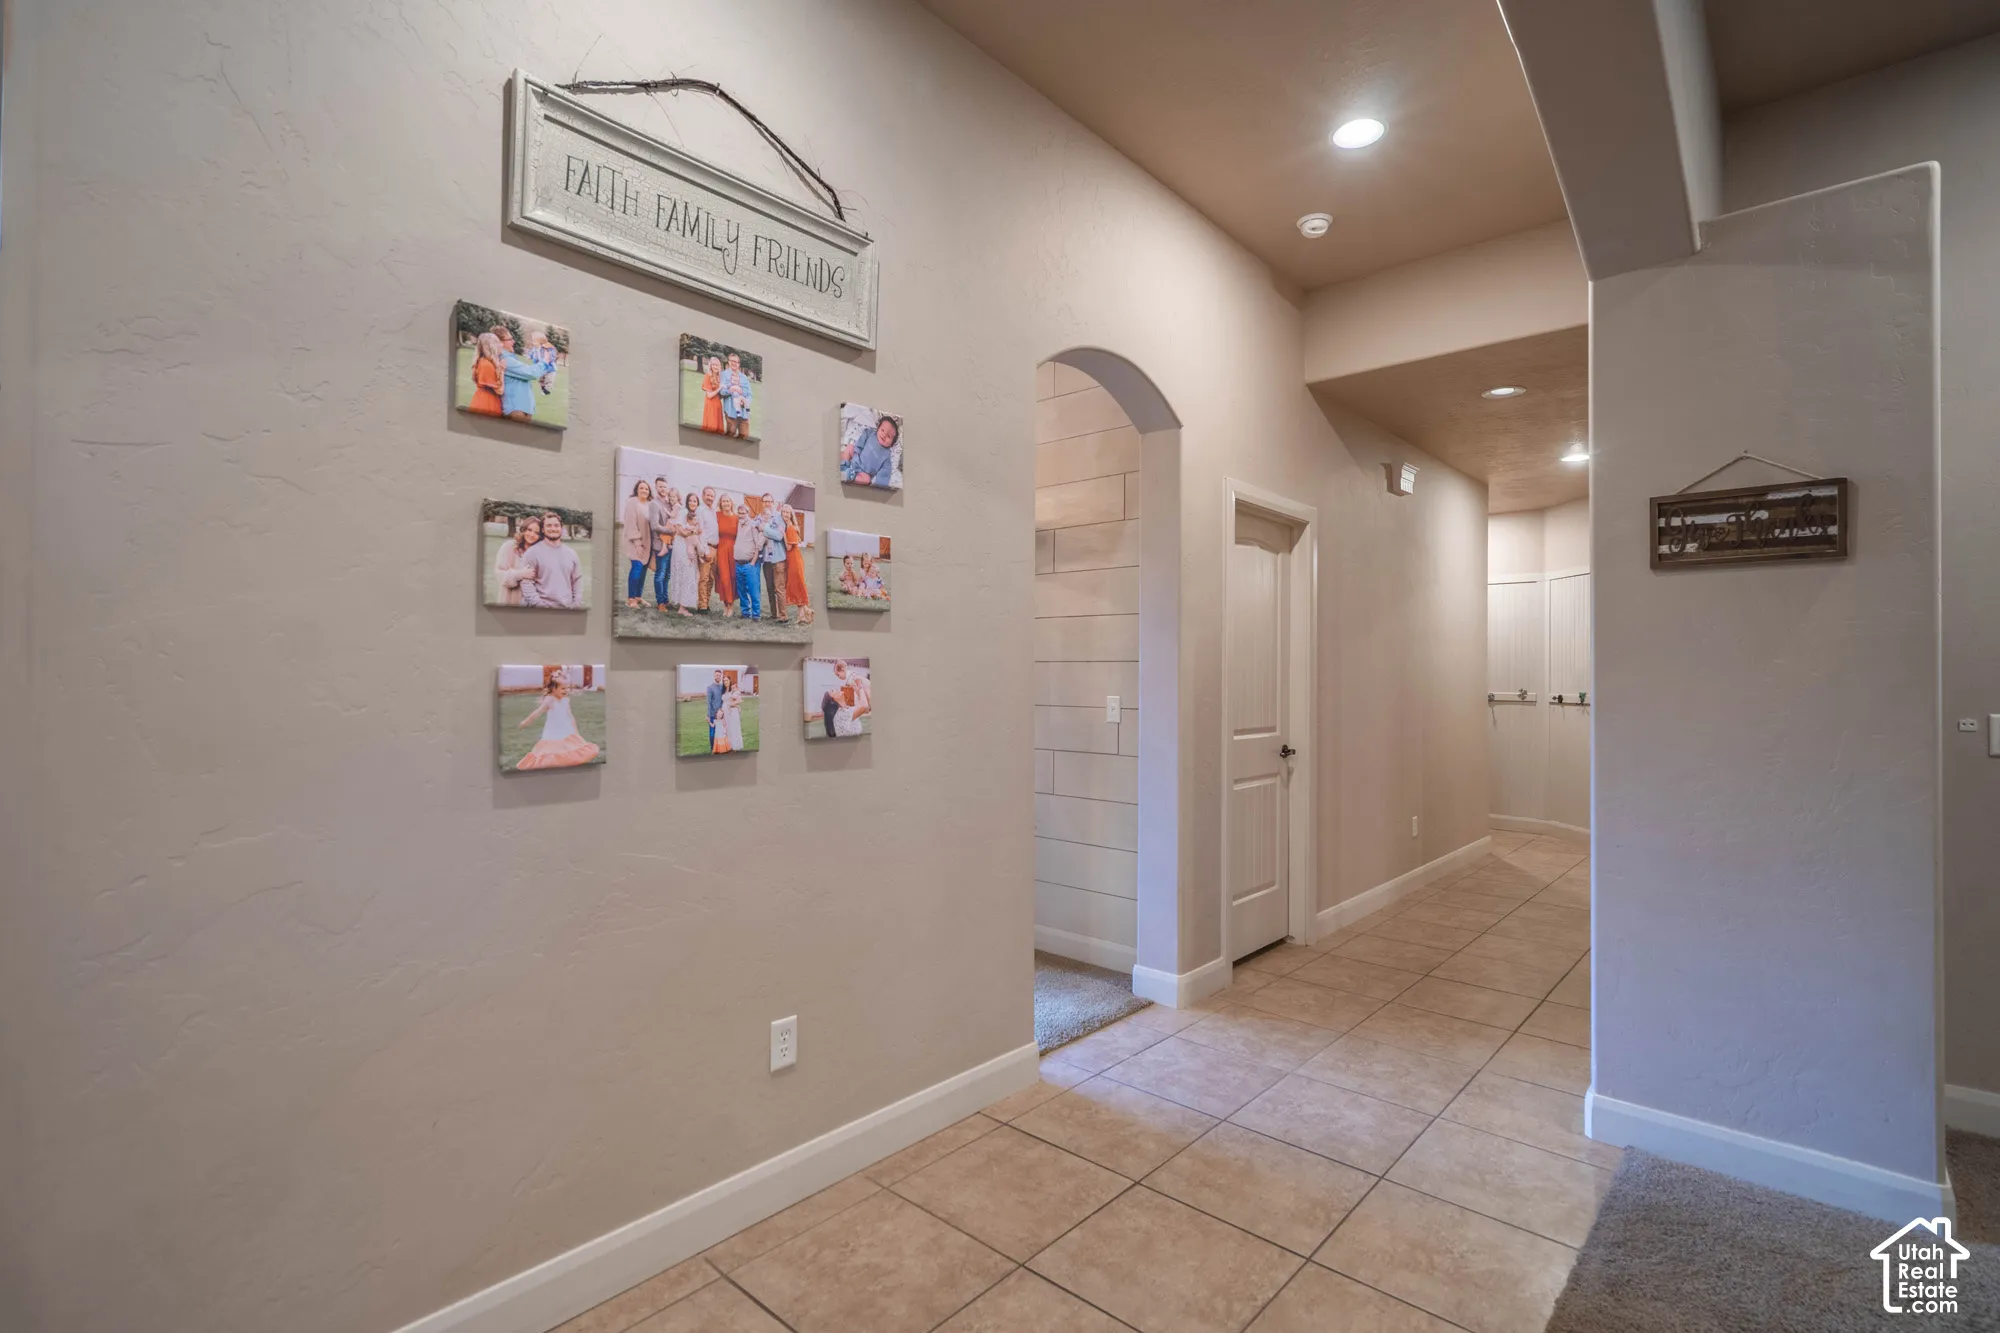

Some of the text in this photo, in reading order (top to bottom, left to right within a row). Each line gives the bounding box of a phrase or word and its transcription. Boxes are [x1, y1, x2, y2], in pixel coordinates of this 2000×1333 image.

[563, 154, 846, 299] FAITH FAMILY FRIENDS
